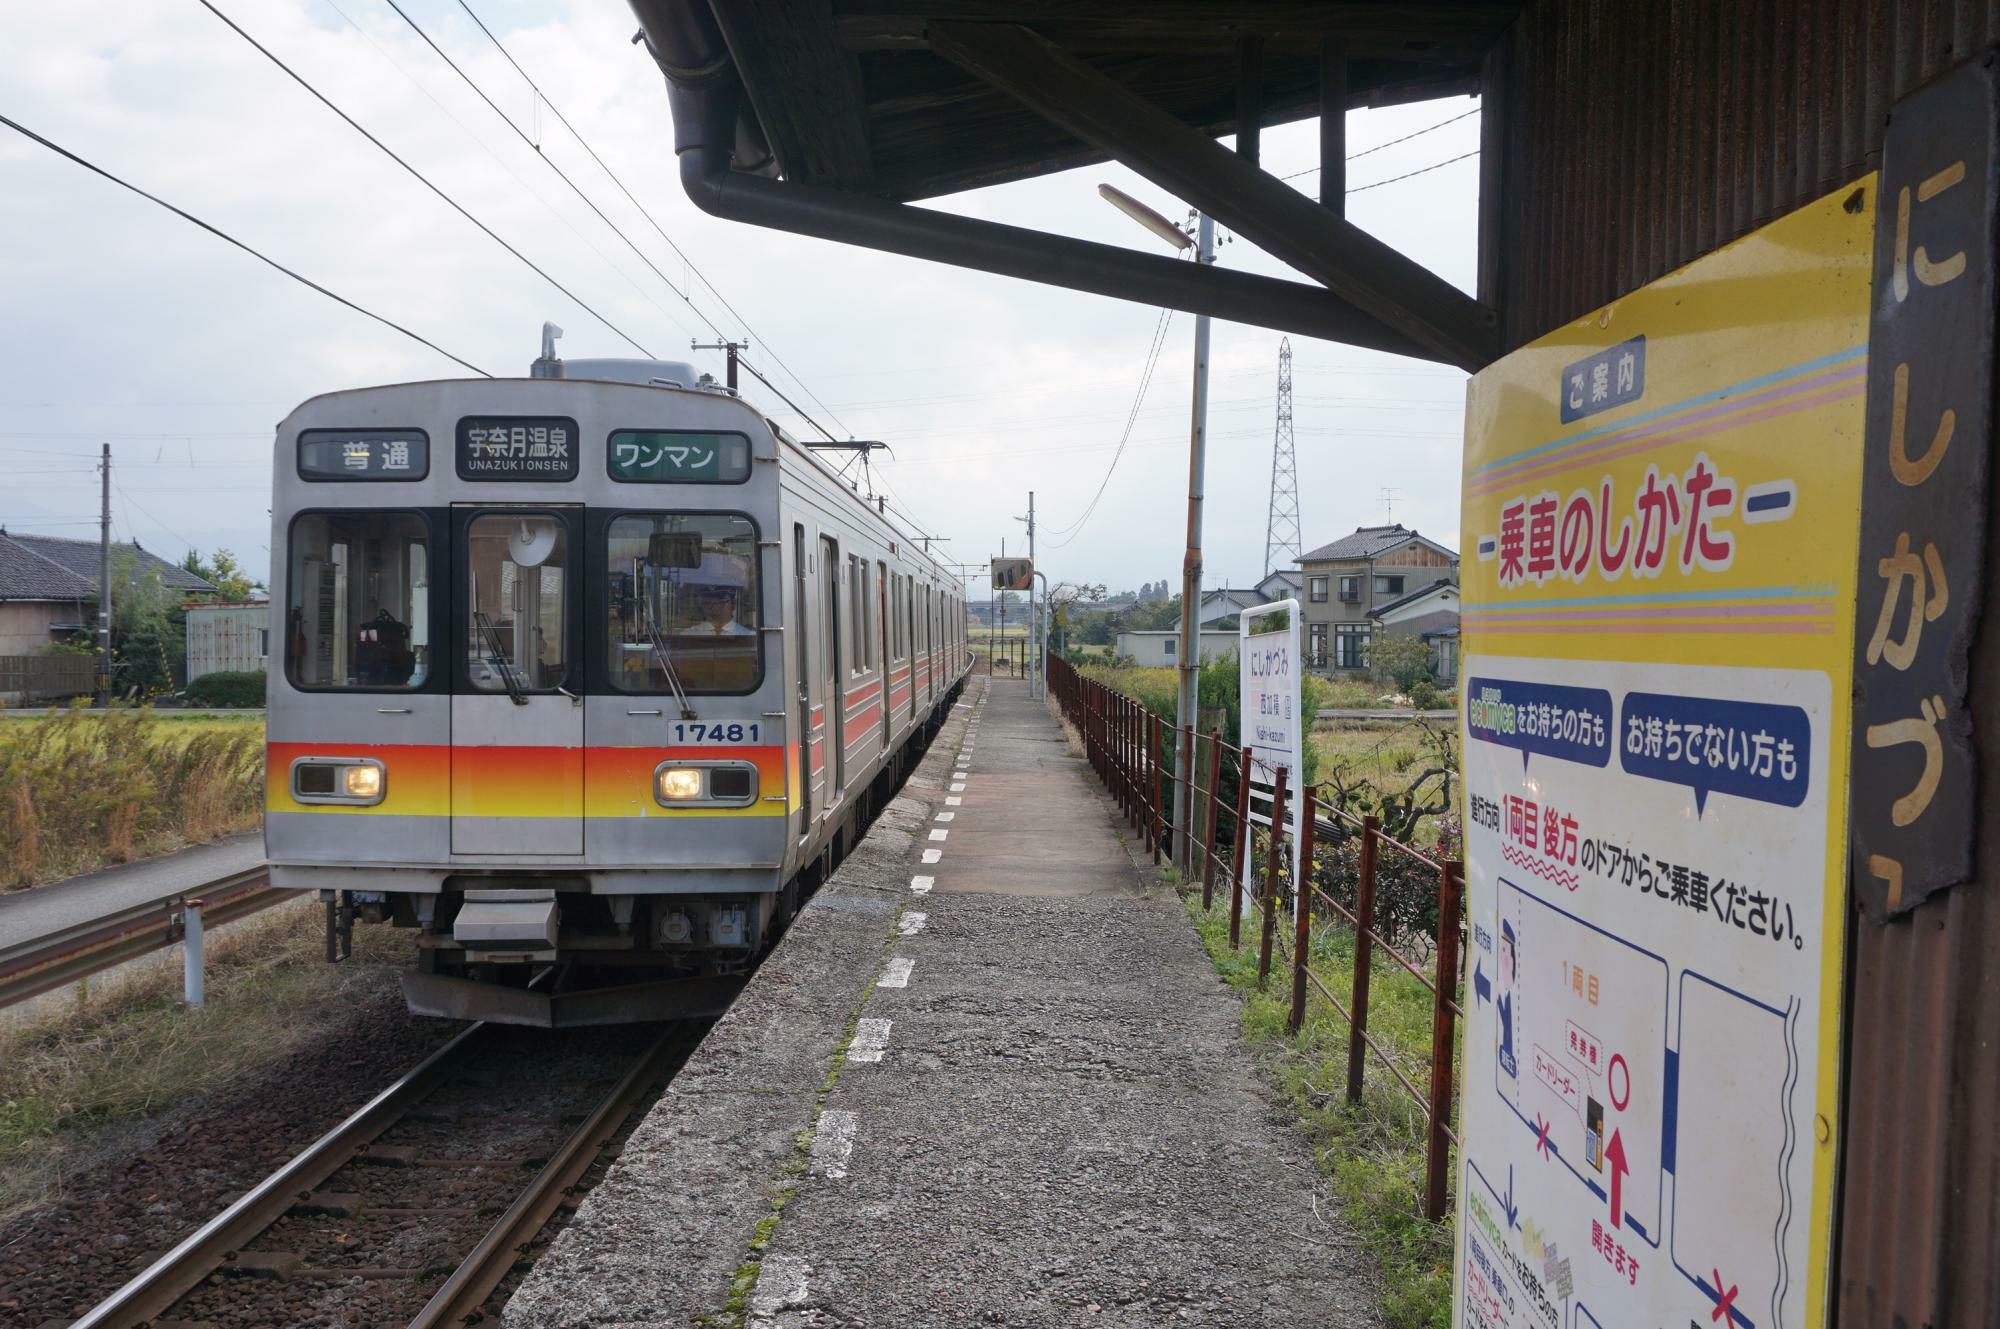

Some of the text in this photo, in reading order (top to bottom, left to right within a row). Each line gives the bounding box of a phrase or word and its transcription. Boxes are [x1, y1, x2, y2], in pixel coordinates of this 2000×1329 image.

[1570, 352, 1635, 410] ご案内
[342, 440, 411, 470] 普通
[468, 427, 568, 458] 宇奈月温泉
[616, 444, 715, 469] ワンマン
[1499, 461, 1732, 583] 乗車のしかた
[1251, 648, 1289, 678] にしかづみ
[674, 724, 761, 743] 17481
[1517, 702, 1606, 748] をお持ちの方も
[1626, 714, 1798, 781] お持ちでない方も
[1470, 793, 1804, 951] 進行方向 1両目 後方 のドアからご乗車ください。
[1535, 1054, 1577, 1095] カードリーダー
[1592, 1218, 1640, 1286] 開きます
